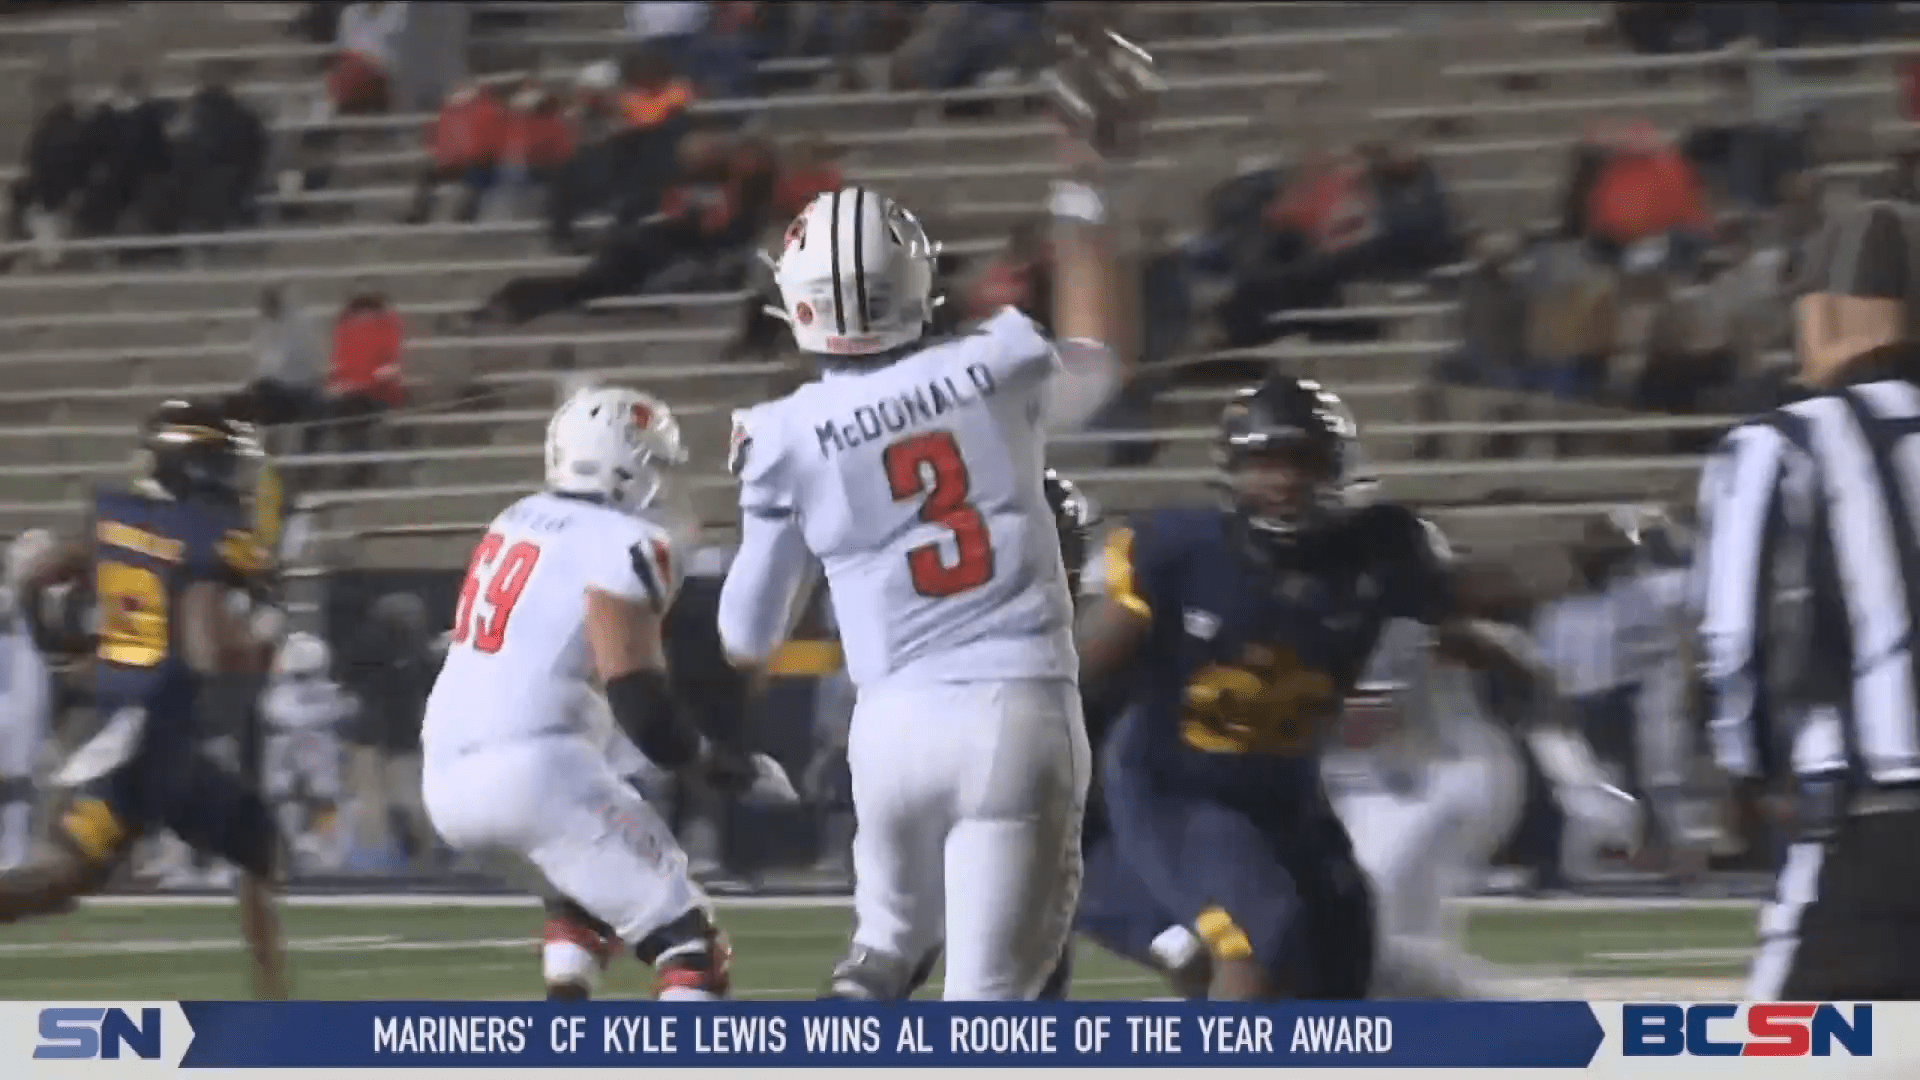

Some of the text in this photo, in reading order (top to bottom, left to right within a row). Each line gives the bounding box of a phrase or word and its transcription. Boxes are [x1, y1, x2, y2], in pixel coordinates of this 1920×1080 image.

[814, 363, 996, 458] McDONALD
[882, 432, 996, 598] 3
[452, 532, 540, 654] 69
